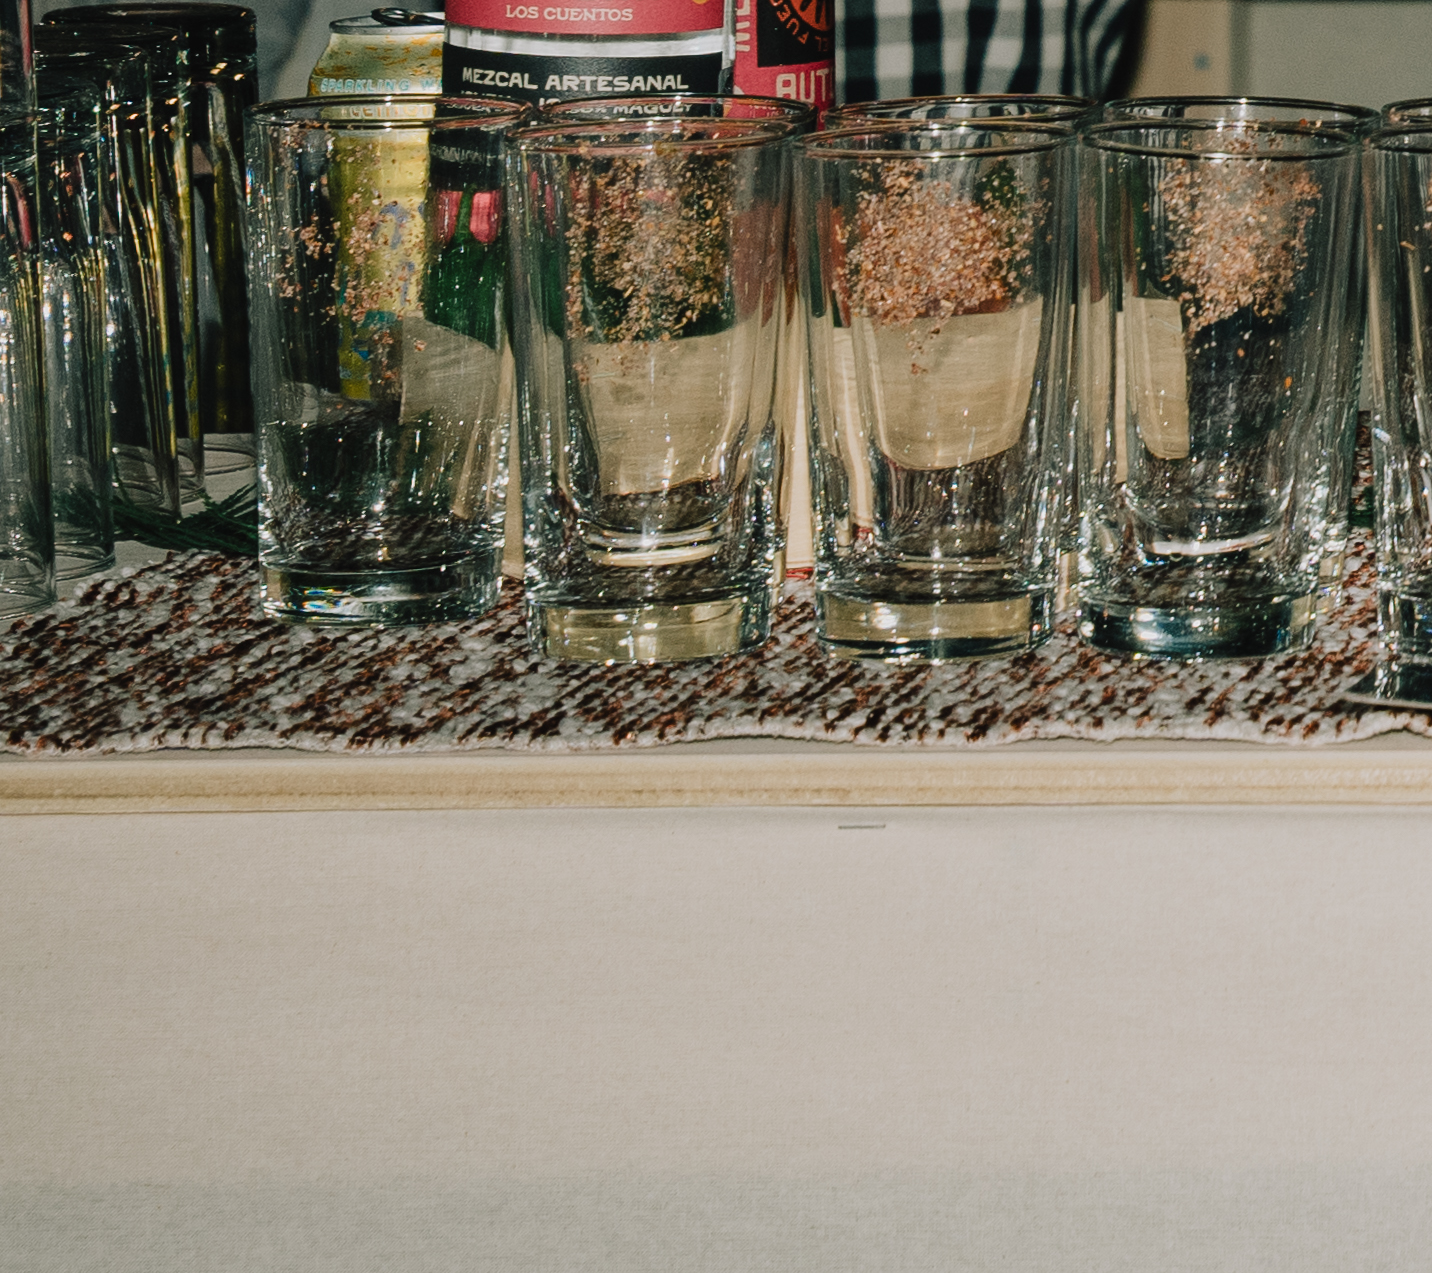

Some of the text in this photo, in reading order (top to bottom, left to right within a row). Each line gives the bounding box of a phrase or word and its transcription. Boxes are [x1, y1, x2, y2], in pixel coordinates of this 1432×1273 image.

[505, 5, 634, 22] LOS CUENTOS
[320, 78, 410, 93] SPARKLING
[462, 66, 689, 92] MEZCAL ARTESANAL
[775, 67, 834, 104] AUT
